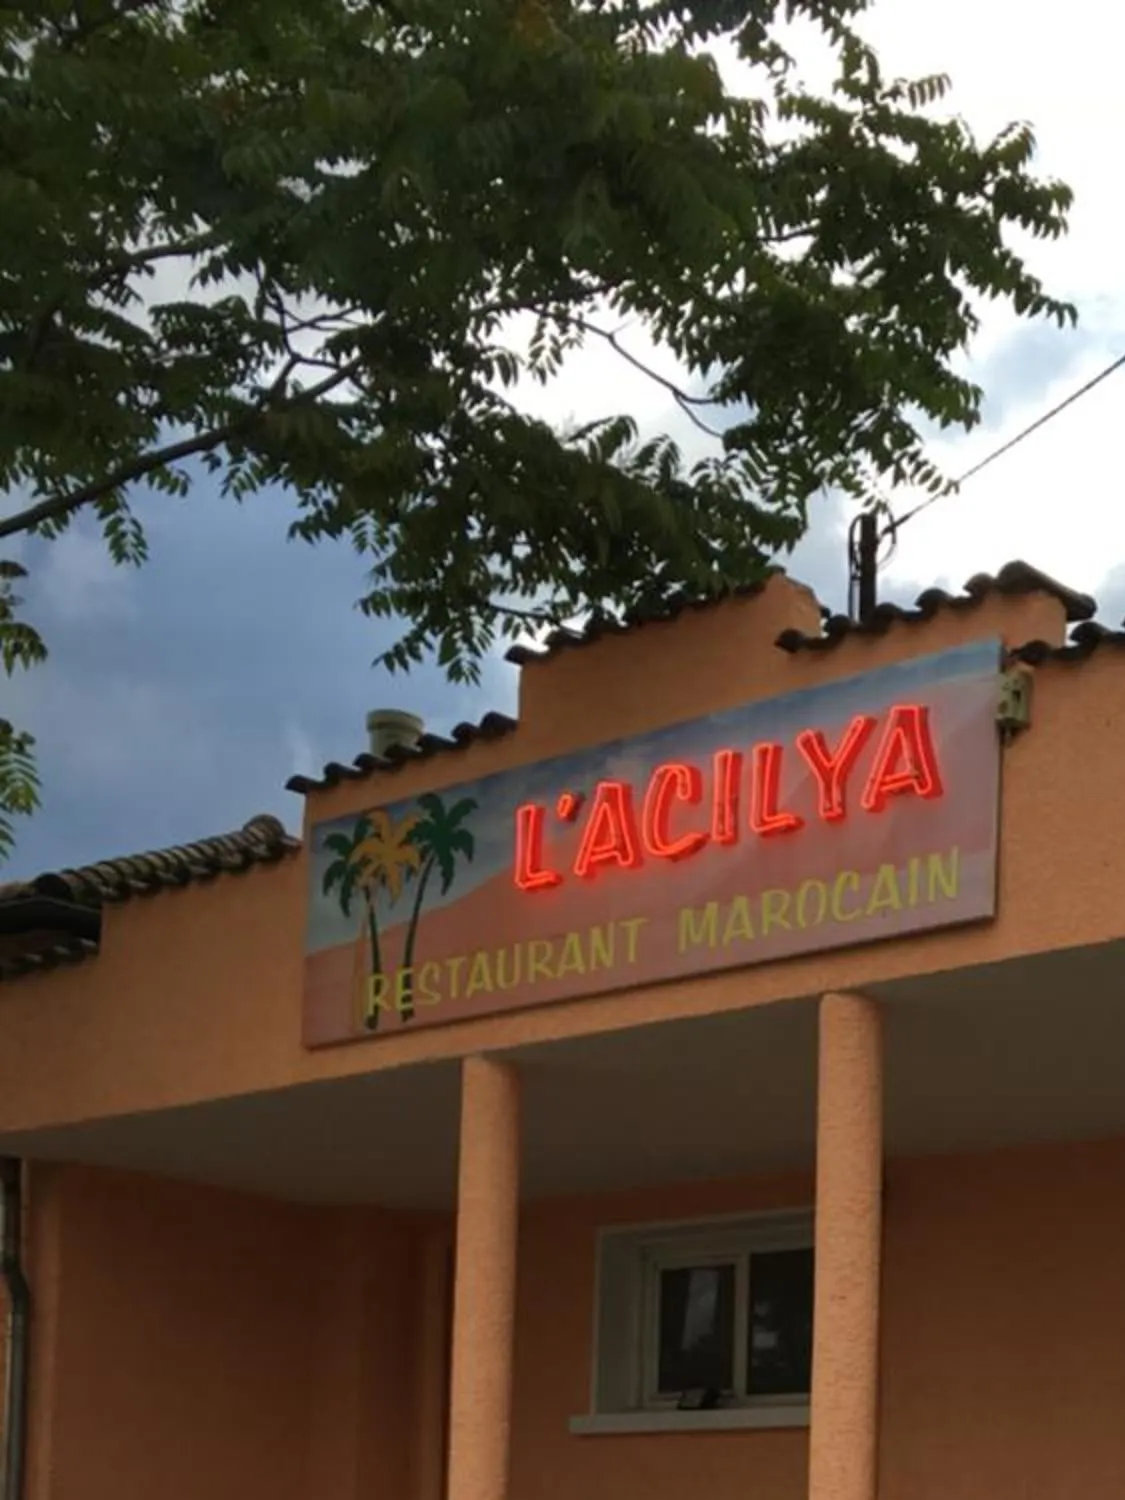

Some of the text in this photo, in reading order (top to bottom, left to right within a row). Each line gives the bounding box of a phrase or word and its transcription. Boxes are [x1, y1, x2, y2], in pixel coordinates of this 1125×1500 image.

[514, 704, 940, 891] L'ACILYA
[365, 846, 961, 1016] RESTAURANT MAROCAIN
